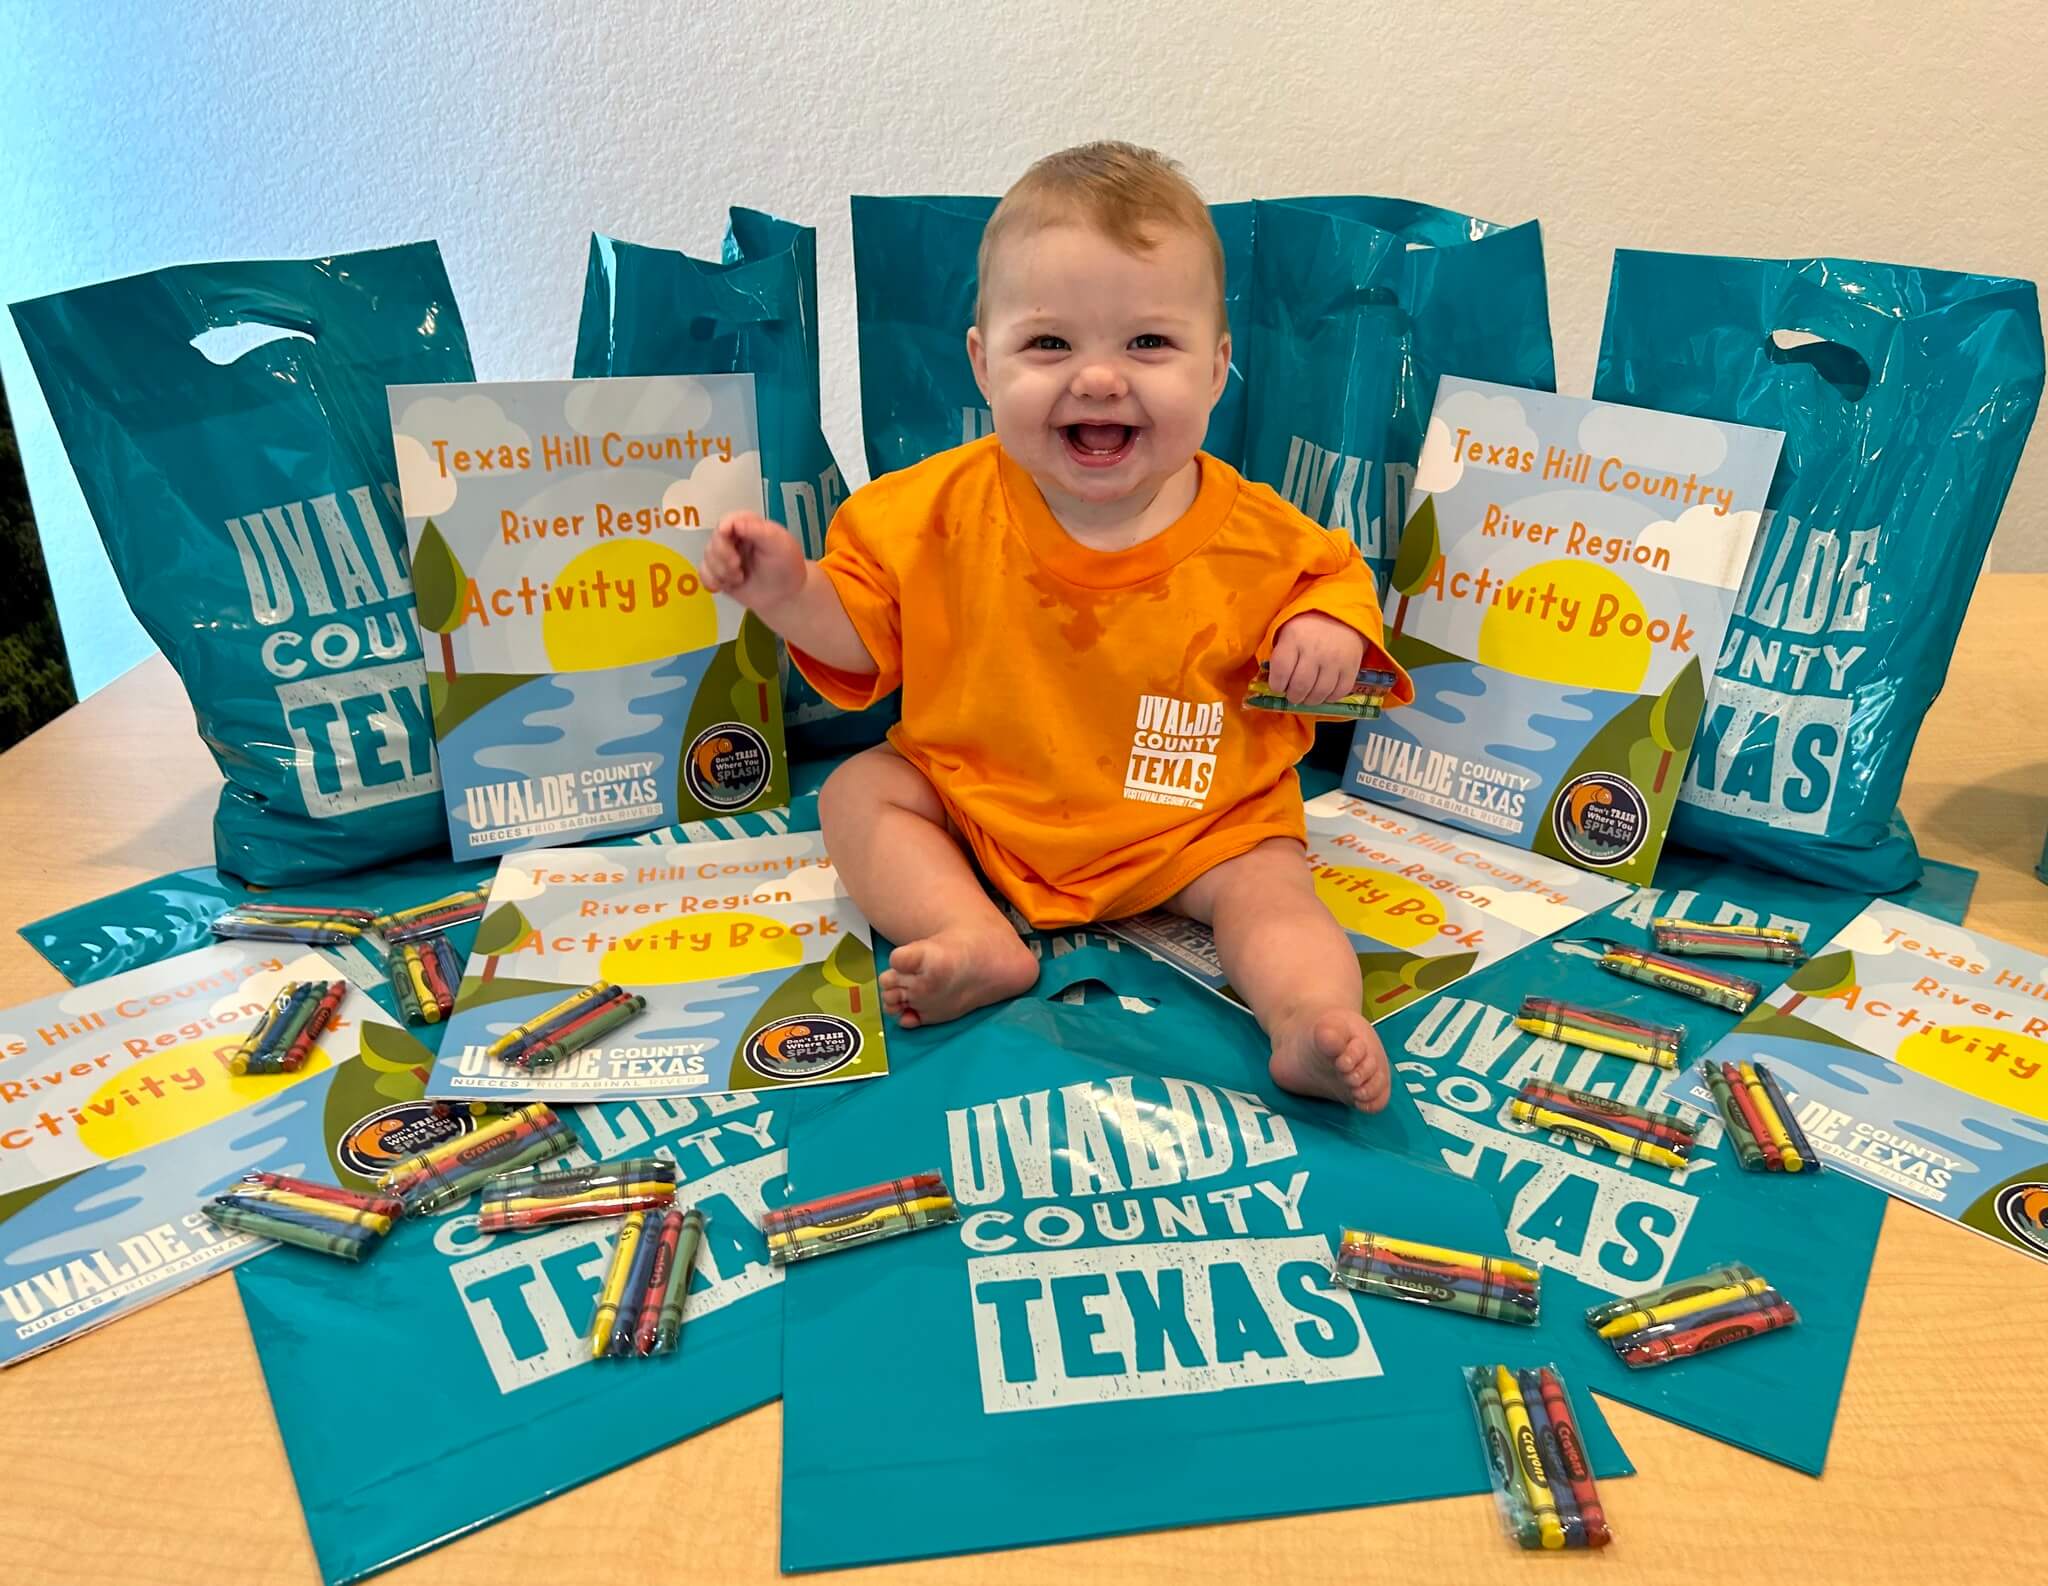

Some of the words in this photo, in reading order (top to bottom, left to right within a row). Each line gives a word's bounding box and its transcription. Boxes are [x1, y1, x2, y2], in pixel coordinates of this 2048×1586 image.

[432, 439, 531, 478] Texas
[542, 435, 591, 472] Hill
[602, 430, 733, 468] Country
[1454, 428, 1535, 473] Texas
[1541, 446, 1589, 484] Hill
[1598, 458, 1734, 516] Country
[501, 508, 584, 544] River
[596, 504, 700, 546] Region
[1482, 504, 1558, 547] River
[1566, 521, 1671, 572] Region
[225, 486, 413, 625] UVAL
[459, 570, 636, 628] Activity
[649, 562, 698, 608] Bo
[1423, 556, 1580, 632] Activity
[1589, 593, 1696, 653] Book
[261, 610, 423, 678] COU
[1136, 695, 1224, 736] UVALDE
[1134, 730, 1220, 753] COUNTY
[716, 761, 742, 771] Where
[744, 759, 759, 768] You
[717, 765, 760, 781] SPLASH
[1131, 754, 1212, 793] TEXAS
[1362, 732, 1458, 796] UVALDE
[1462, 761, 1532, 793] COUNTY
[464, 773, 578, 830] UVALDE
[581, 761, 653, 786] COUNTY
[581, 779, 658, 812] TEXAS
[1358, 773, 1399, 793] NUECES
[1401, 785, 1426, 802] FRIO
[1430, 796, 1477, 818] SABINAL
[1480, 812, 1520, 833] RIVERS
[1458, 777, 1526, 818] TEXAS
[1610, 808, 1636, 823] TRASH
[471, 828, 522, 844] NUECES
[526, 822, 556, 835] FRIO
[560, 812, 613, 831] SABINAL
[617, 804, 661, 820] RIVERS
[1584, 819, 1632, 841] SPLASH
[1587, 811, 1615, 826] Where
[1617, 819, 1633, 831] You
[531, 867, 625, 886] Texas
[637, 864, 687, 884] Hill
[696, 854, 833, 881] Country
[1330, 834, 1400, 866] River
[1399, 863, 1492, 909] Region
[1337, 799, 1408, 836] Texas
[1408, 831, 1456, 856] Hill
[1453, 851, 1569, 905] Country
[580, 898, 669, 918] River
[680, 890, 792, 915] Region
[1306, 853, 1389, 904] tivity
[1384, 898, 1485, 948] Book
[515, 928, 711, 956] Activity
[729, 915, 839, 948] Book
[1883, 928, 1984, 975] Texas
[37, 1012, 107, 1046] Hill
[115, 957, 285, 1018] Country
[1658, 976, 1702, 995] Crayons
[1912, 976, 2014, 1021] River
[0, 1053, 112, 1103] River
[123, 1001, 266, 1060] Region
[609, 1044, 705, 1060] COUNTY
[786, 1037, 811, 1045] Don't
[786, 1042, 822, 1050] Where
[786, 1044, 846, 1057] SPLASH
[1826, 985, 2041, 1079] Activity
[453, 1078, 519, 1088] NUECES
[526, 1080, 563, 1089] FRIO
[570, 1079, 641, 1089] SABINAL
[608, 1056, 704, 1078] TEXAS
[1, 1066, 206, 1149] ctivity
[384, 1127, 411, 1143] Don't
[410, 1115, 439, 1129] TRAS
[388, 1128, 427, 1146] Where
[427, 1118, 451, 1130] You
[393, 1122, 458, 1152] SPLASH
[461, 1132, 511, 1161] Crayons
[945, 1076, 1298, 1206] UVALDE
[1855, 1122, 1962, 1170] COUNTY
[1811, 1138, 1876, 1173] ABINAL
[1850, 1131, 1952, 1189] TEXAS
[960, 1171, 1310, 1251] COUNTY
[0, 1223, 192, 1323] UVALDE
[1392, 1278, 1449, 1299] Crayons
[20, 1293, 104, 1337] NUECES
[976, 1258, 1361, 1383] TEXAS
[1521, 1431, 1547, 1483] Crayons
[1558, 1426, 1585, 1476] Crayons
